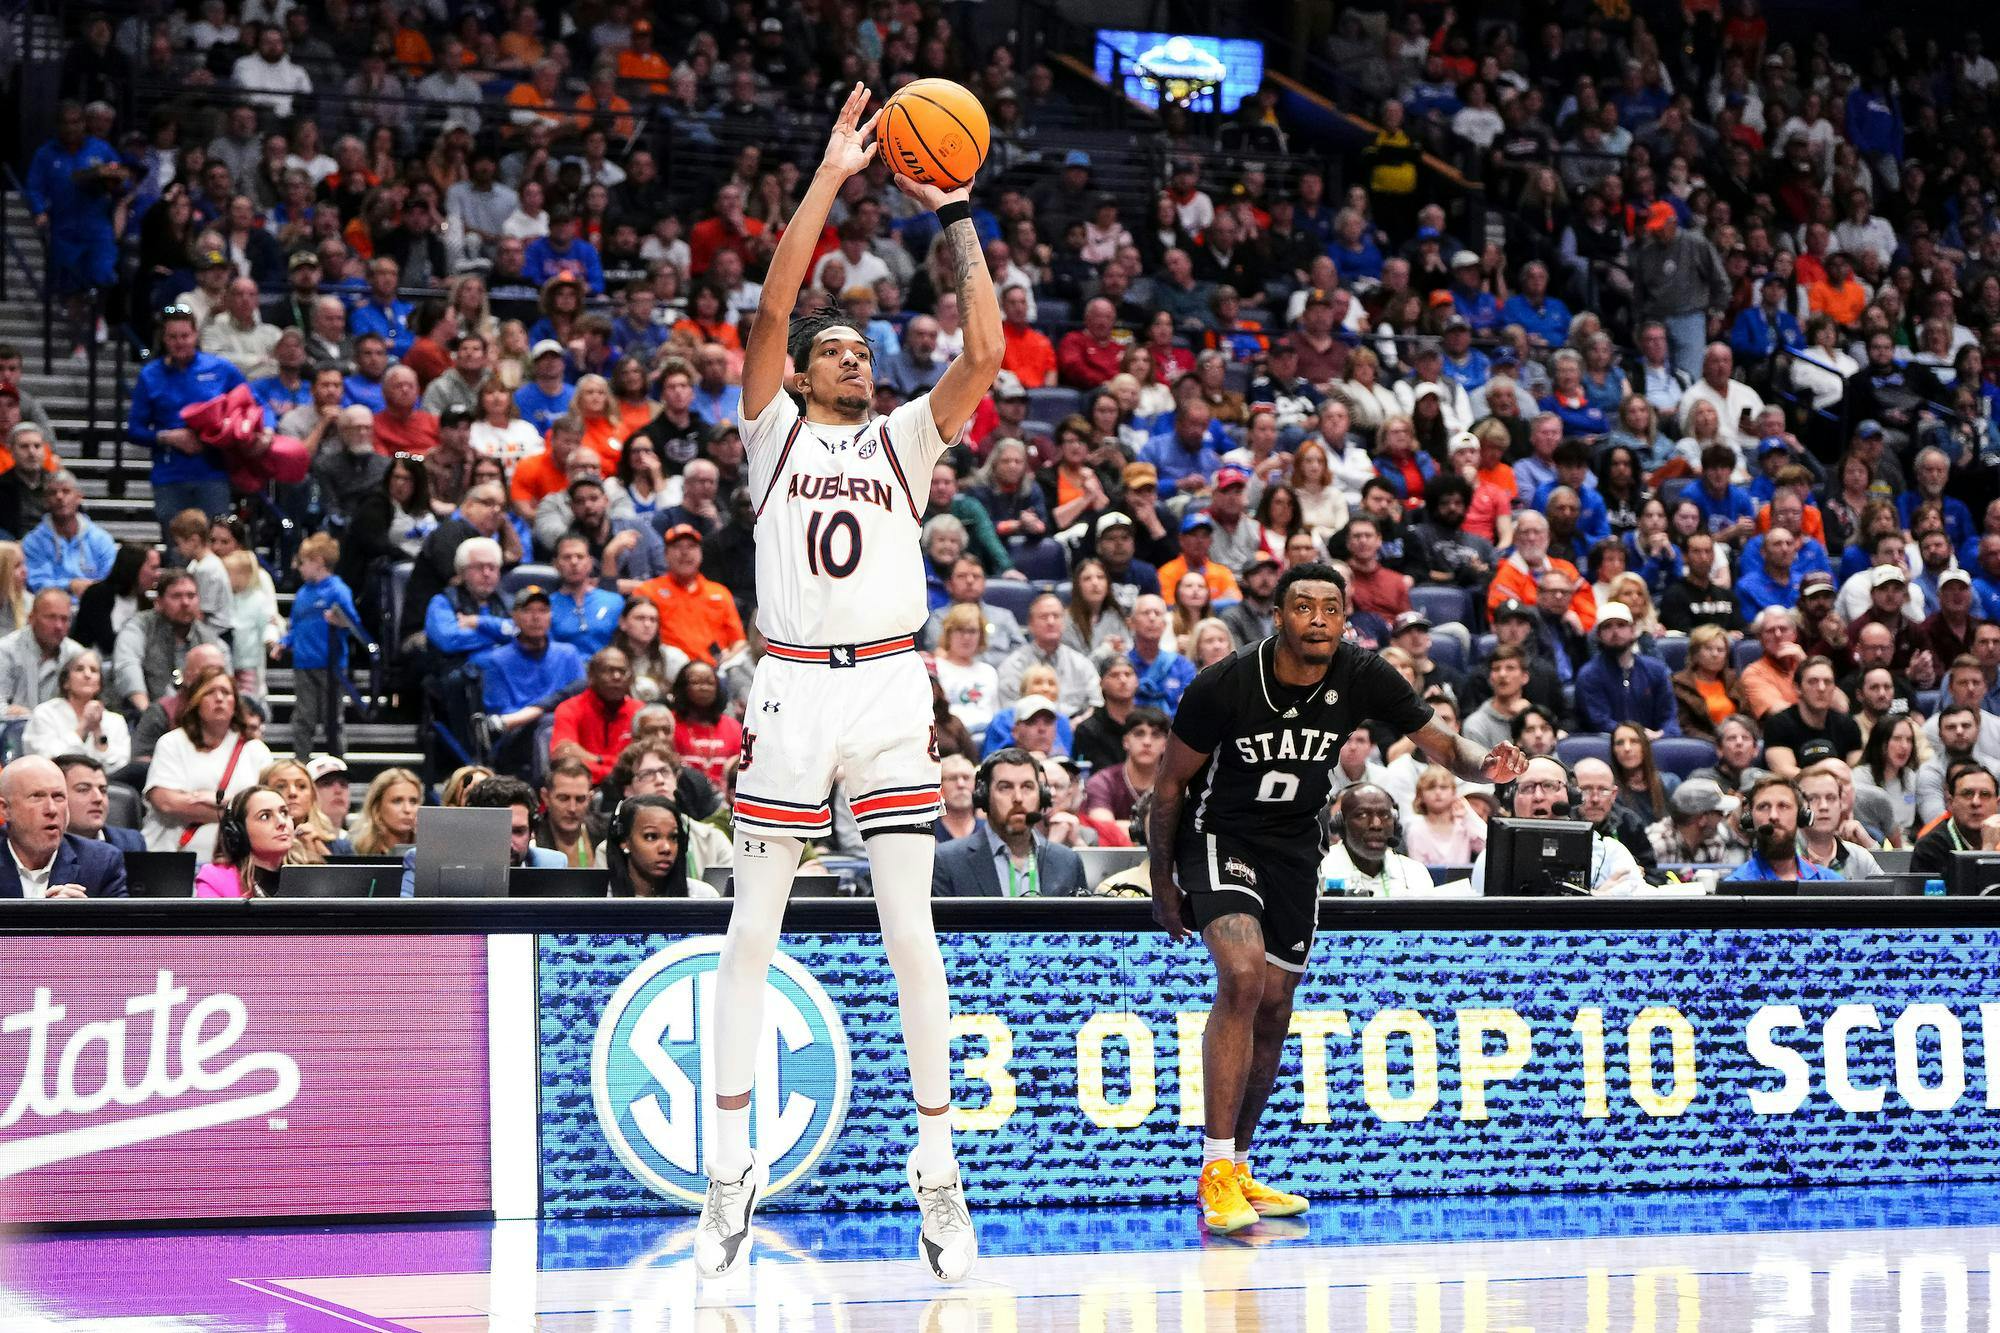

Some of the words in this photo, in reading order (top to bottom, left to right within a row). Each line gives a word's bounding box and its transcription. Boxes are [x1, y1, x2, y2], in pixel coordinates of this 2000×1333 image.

[900, 151, 935, 181] EVO
[807, 510, 862, 579] 10
[1235, 728, 1339, 764] STATE
[1254, 769, 1300, 802] 0
[628, 972, 816, 1174] SC
[949, 1013, 1017, 1131] 3
[1284, 1008, 1439, 1123] TOP
[1571, 1006, 1697, 1118] 10
